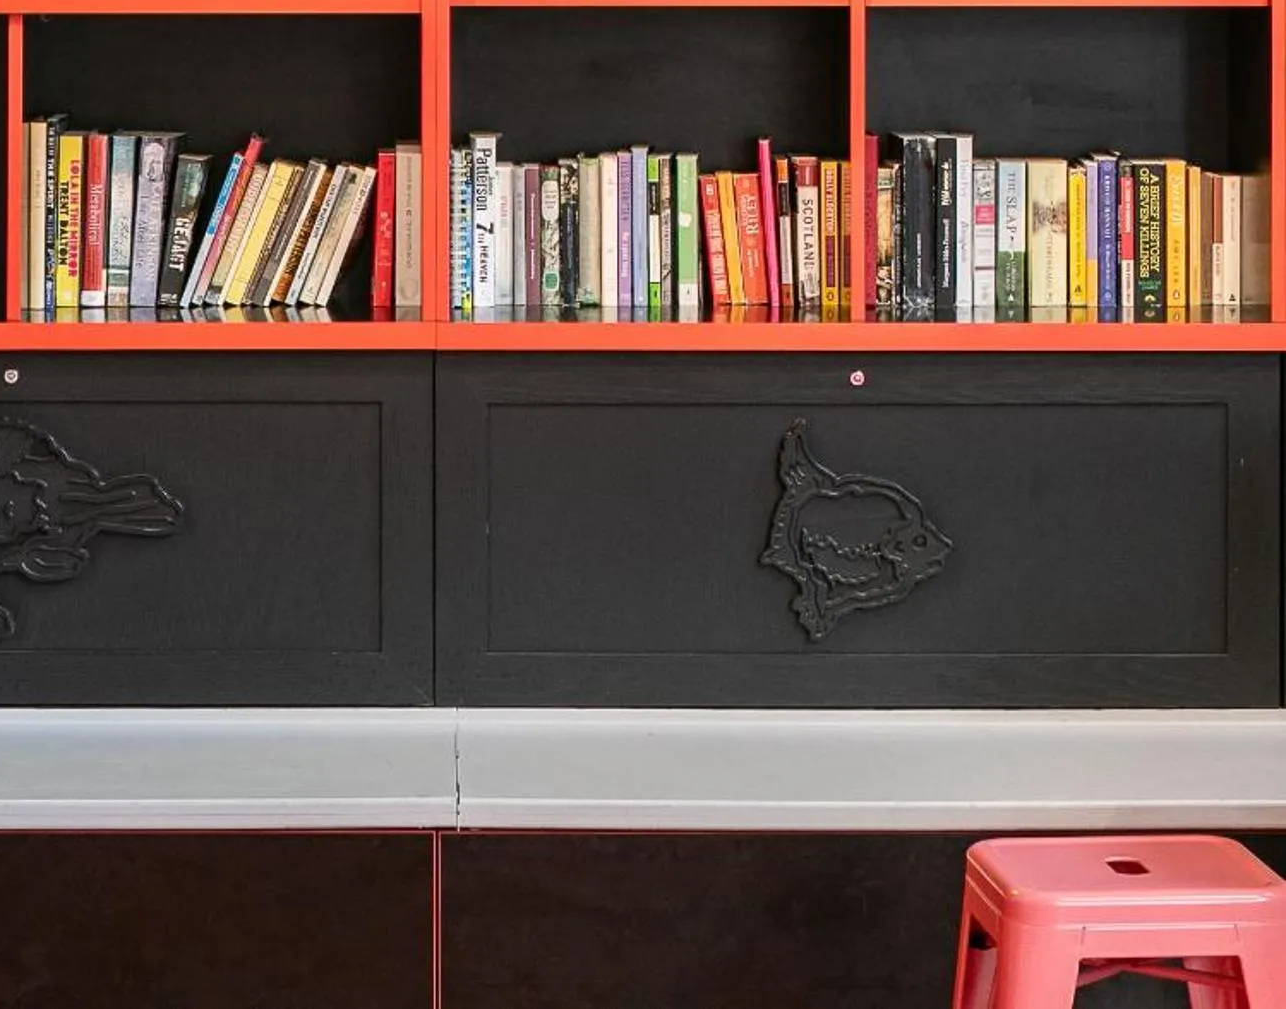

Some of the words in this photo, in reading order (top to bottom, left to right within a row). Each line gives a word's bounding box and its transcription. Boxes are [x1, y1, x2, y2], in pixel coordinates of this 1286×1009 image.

[69, 159, 80, 191] LOLA
[475, 148, 492, 211] Patterson
[1007, 173, 1016, 194] THE
[1139, 167, 1150, 183] OF
[1149, 174, 1160, 184] A
[59, 181, 70, 215] TRENT
[69, 192, 80, 205] IN
[1006, 196, 1018, 234] SLAP
[1139, 185, 1150, 224] SEVEN
[1149, 185, 1160, 220] BRIEF
[69, 208, 79, 229] THE
[59, 219, 70, 266] DALTON
[67, 230, 78, 278] MIRROR
[1139, 226, 1150, 279] KILLINGS
[1149, 221, 1160, 273] HISTORY
[479, 245, 489, 283] HEAVEN
